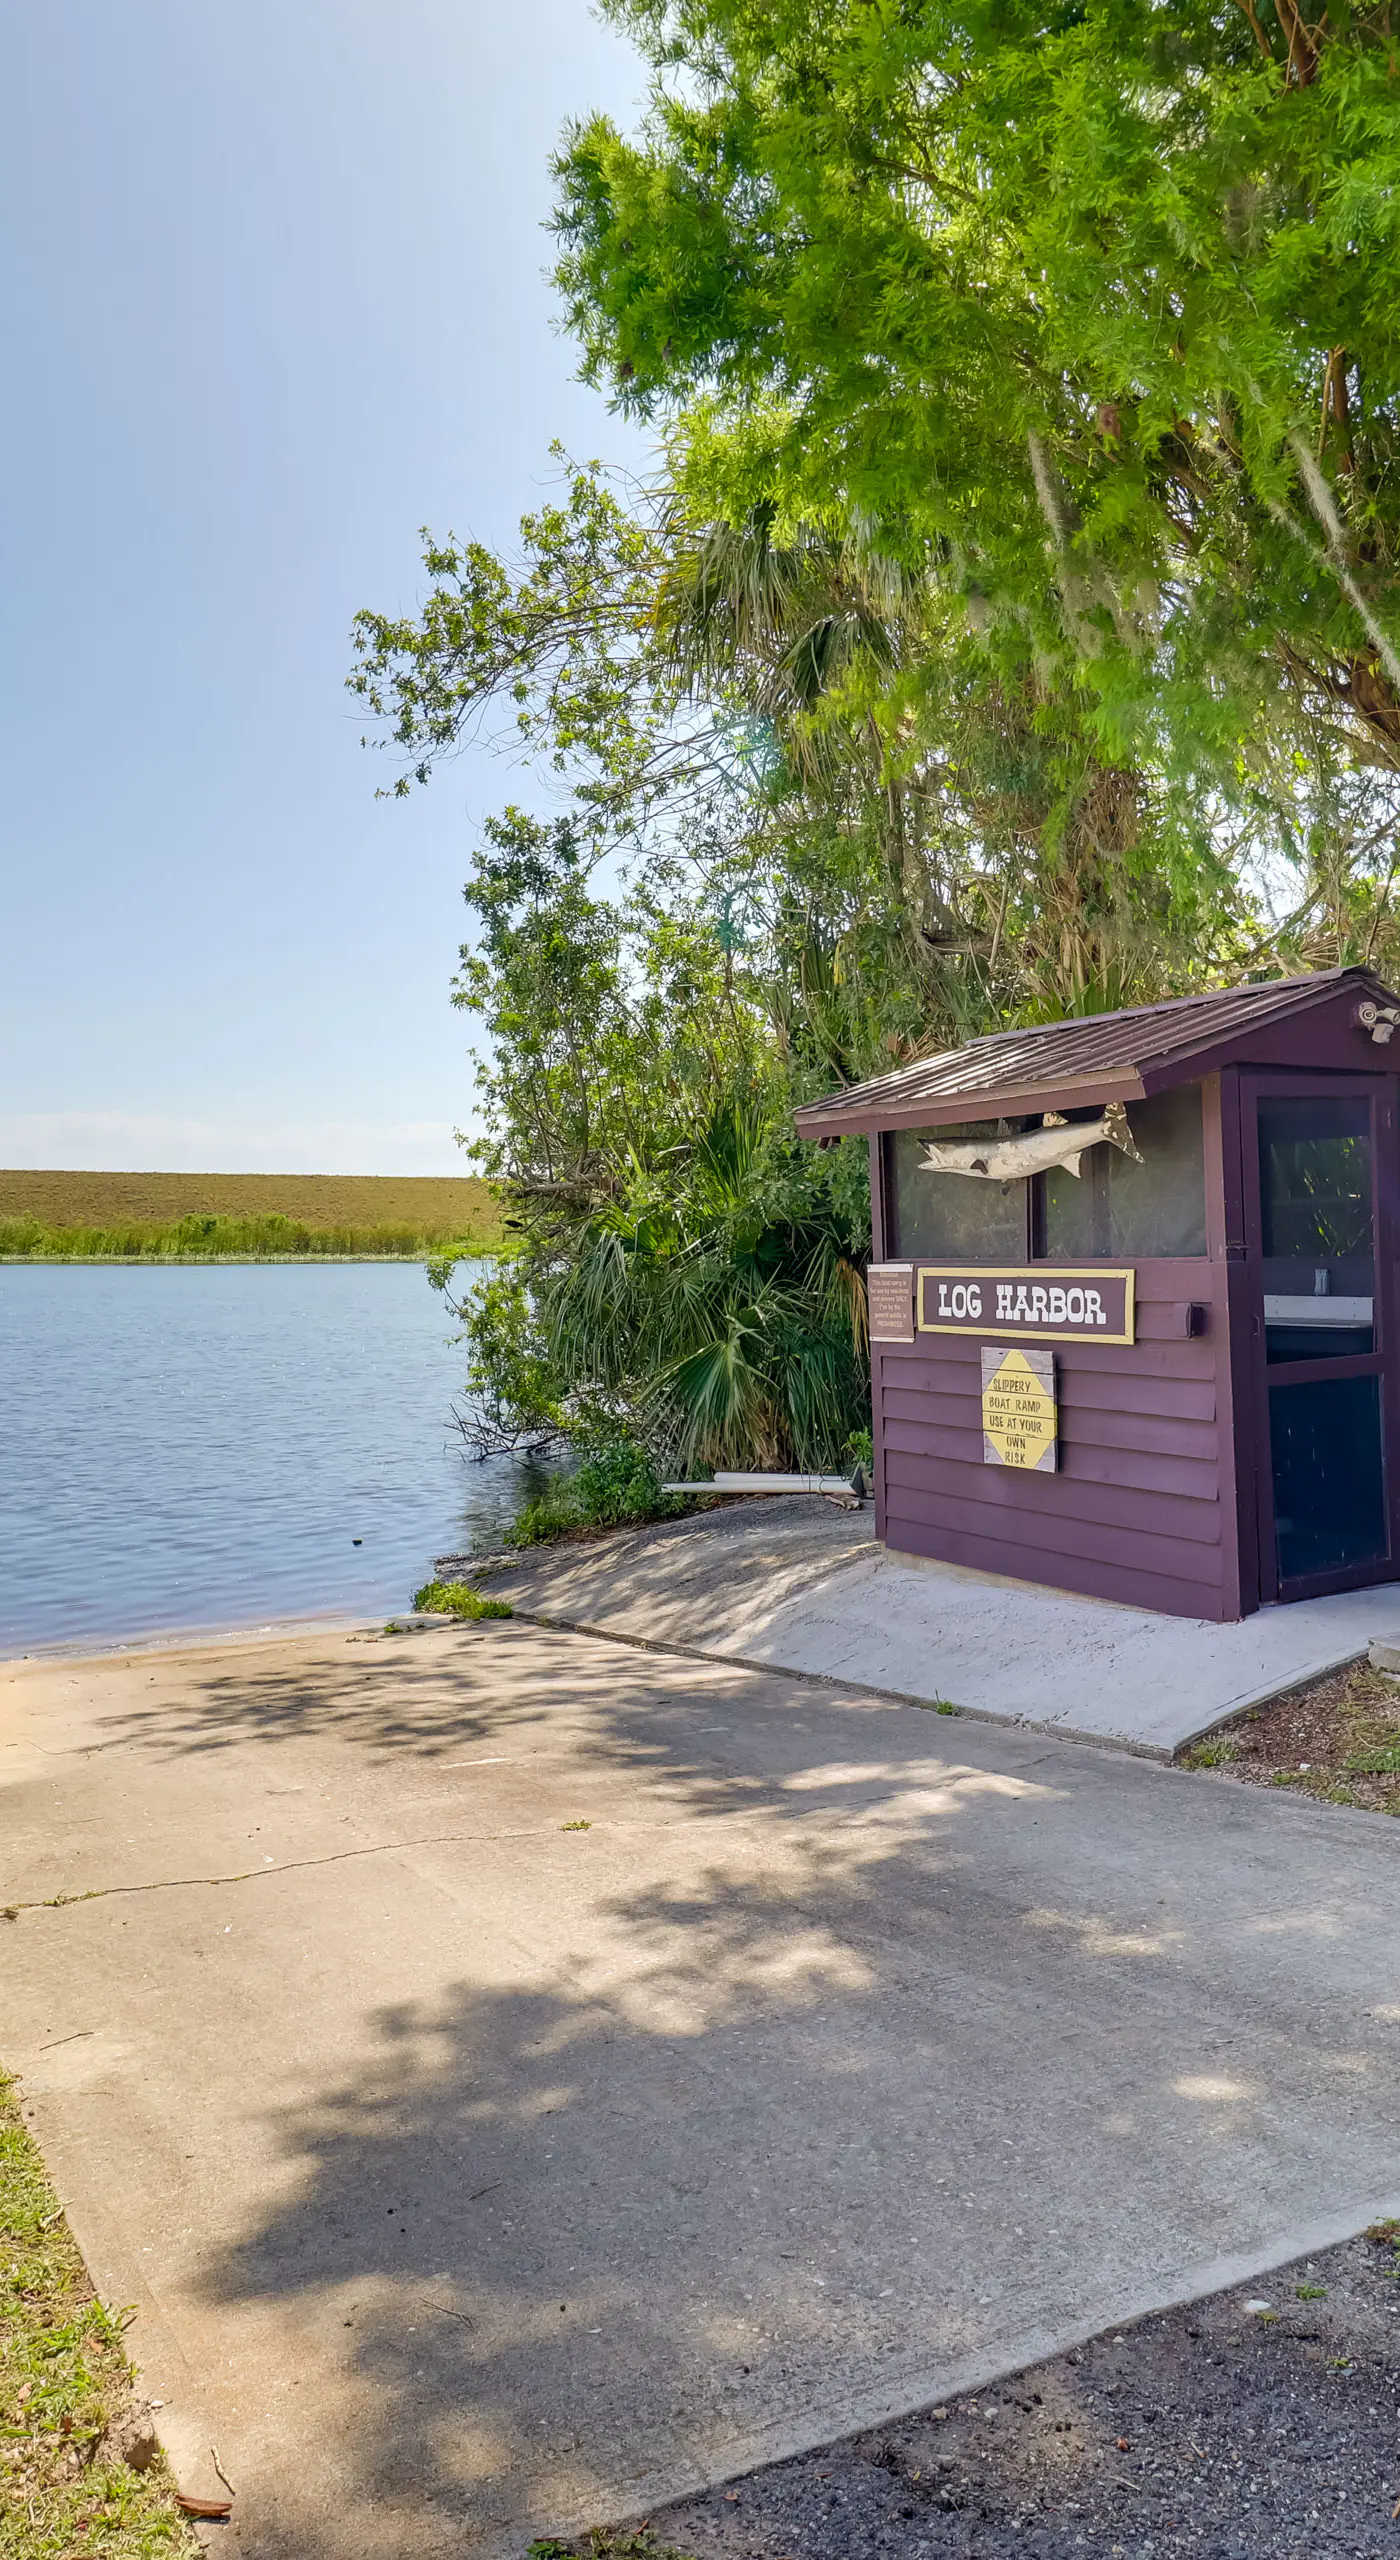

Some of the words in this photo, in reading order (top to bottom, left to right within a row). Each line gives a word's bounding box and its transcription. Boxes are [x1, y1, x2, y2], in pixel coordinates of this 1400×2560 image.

[938, 1284, 983, 1319] LOG
[995, 1284, 1107, 1325] HARBOR
[993, 1378, 1031, 1393] SLIPPERY
[989, 1396, 1010, 1410] BOAT
[1015, 1399, 1041, 1413] RAMP
[989, 1415, 1004, 1428] USE
[1007, 1418, 1017, 1430] AT
[1019, 1418, 1042, 1433] YOUR
[1006, 1435, 1026, 1449] OWN
[1004, 1450, 1026, 1465] RISK
